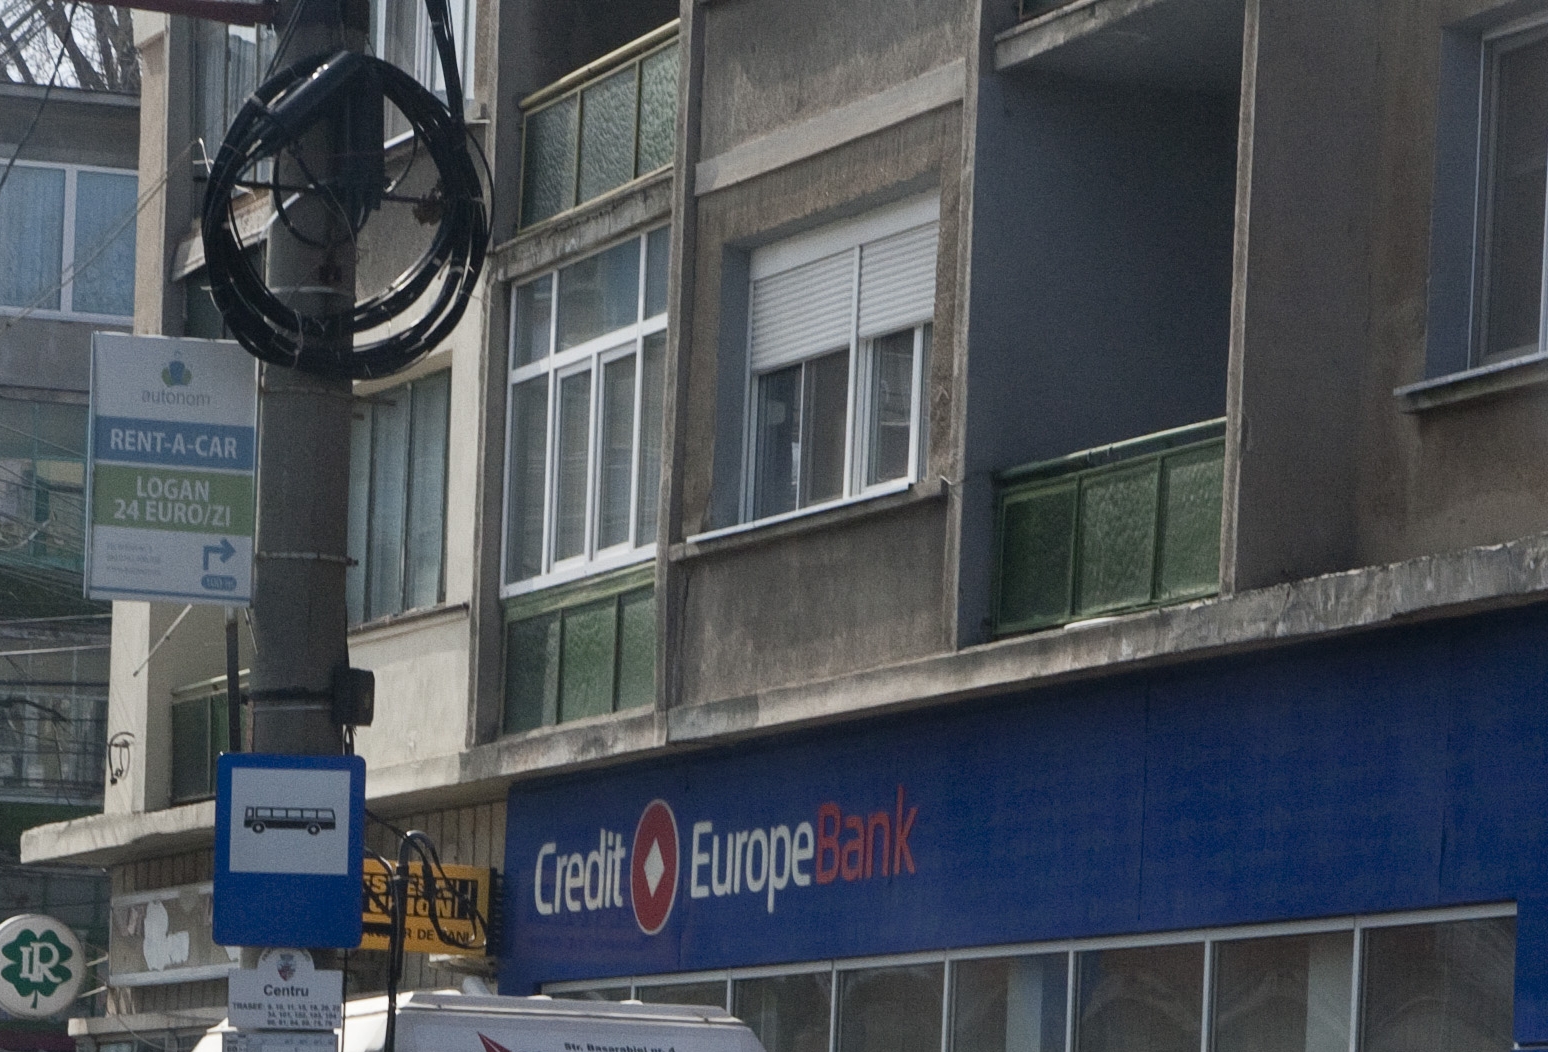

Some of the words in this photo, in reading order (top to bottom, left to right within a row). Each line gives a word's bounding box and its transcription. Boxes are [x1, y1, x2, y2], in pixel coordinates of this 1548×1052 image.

[142, 389, 211, 406] autonom
[110, 428, 237, 459] RENT-A-CAR
[136, 476, 210, 502] LOGAN
[114, 499, 139, 521] 24
[146, 501, 231, 527] EURO/ZI
[535, 829, 626, 916] Credit
[689, 784, 919, 914] EuropeBank
[417, 929, 434, 940] DE
[263, 984, 309, 997] Centru
[564, 1042, 584, 1052] Str.
